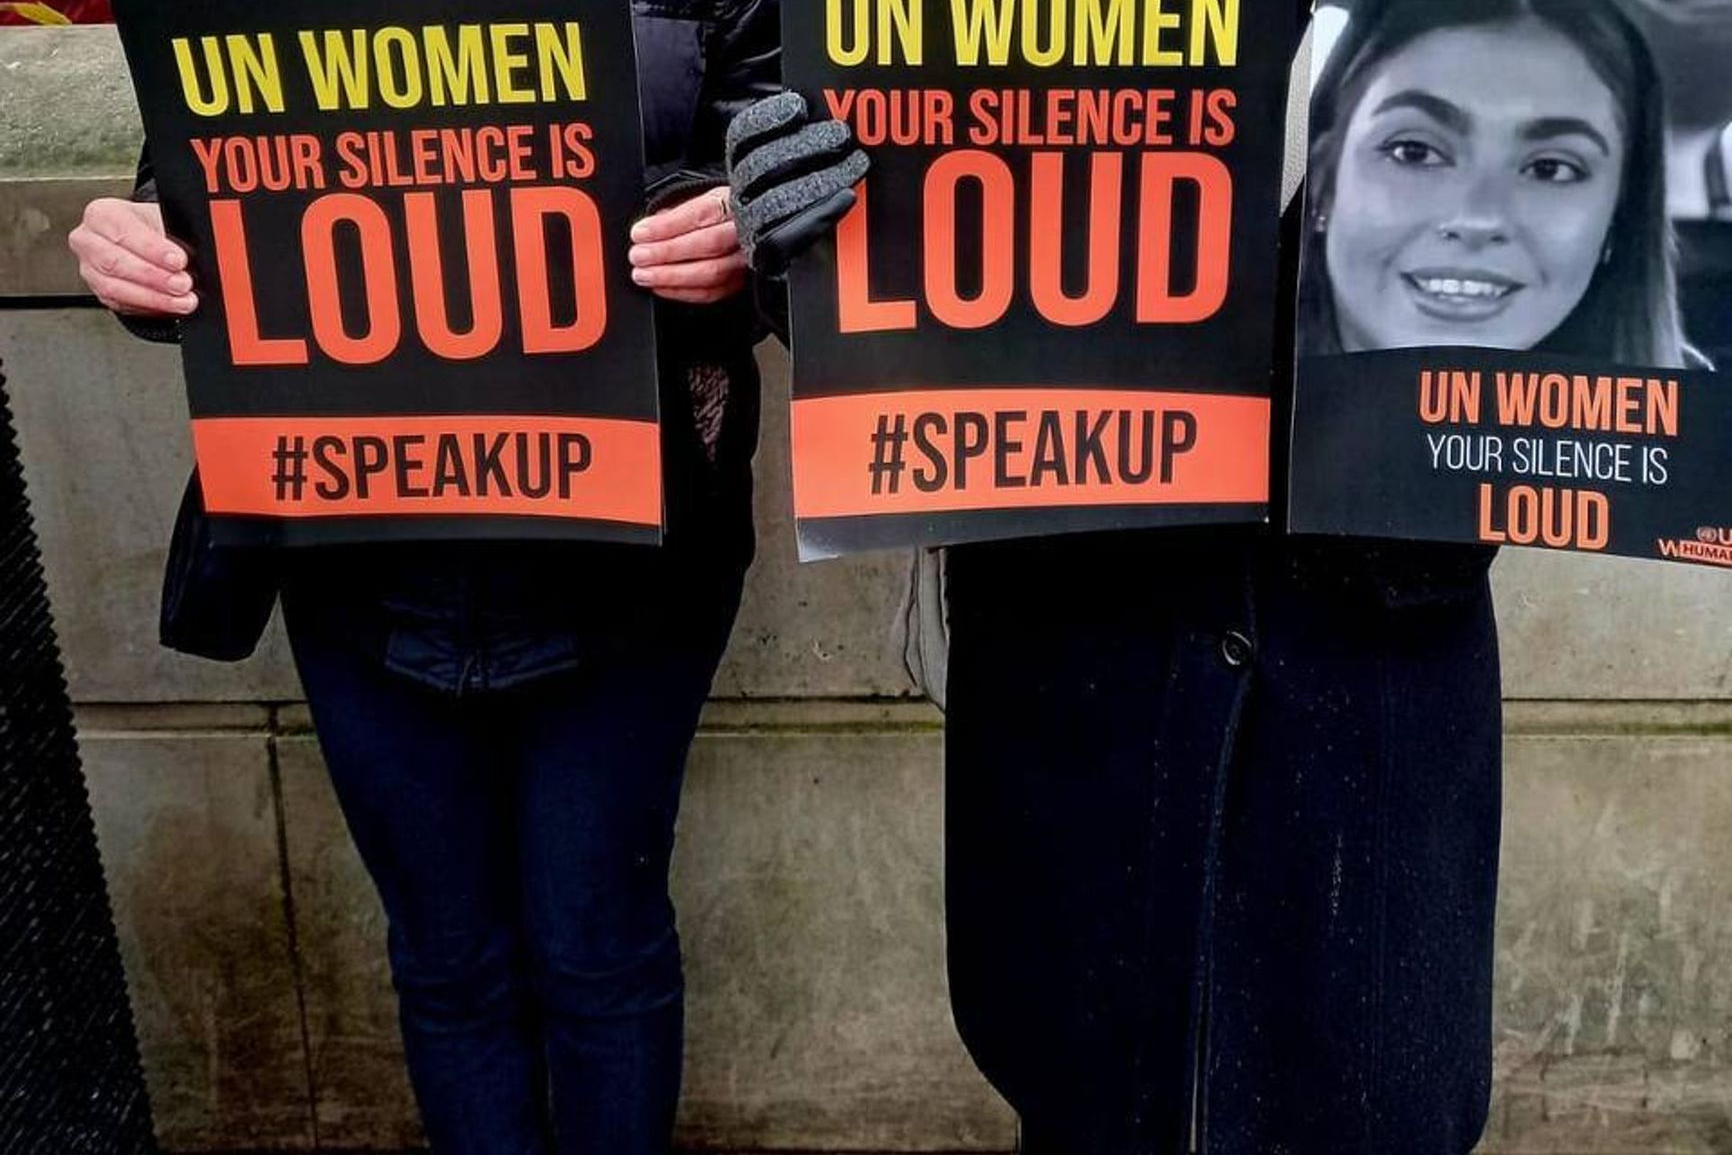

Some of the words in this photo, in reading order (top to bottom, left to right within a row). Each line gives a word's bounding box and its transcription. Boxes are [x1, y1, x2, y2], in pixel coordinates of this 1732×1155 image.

[172, 32, 286, 116] UN
[298, 21, 587, 111] WOMEN
[968, 87, 1175, 147] SILENCE
[1188, 88, 1238, 147] IS
[190, 133, 327, 193] YOUR
[335, 124, 539, 189] SILENCE
[549, 121, 598, 180] IS
[209, 186, 608, 366] LOUD
[835, 149, 1234, 334] LOUD
[1418, 371, 1481, 424] UN
[1495, 373, 1679, 437] WOMEN
[271, 432, 593, 501] #SPEAKUP
[868, 409, 1198, 496] #SPEAKUP
[1426, 434, 1503, 473] YOUR
[1512, 437, 1632, 483] SILENCE
[1642, 446, 1669, 485] IS
[1478, 483, 1610, 551] LOUD
